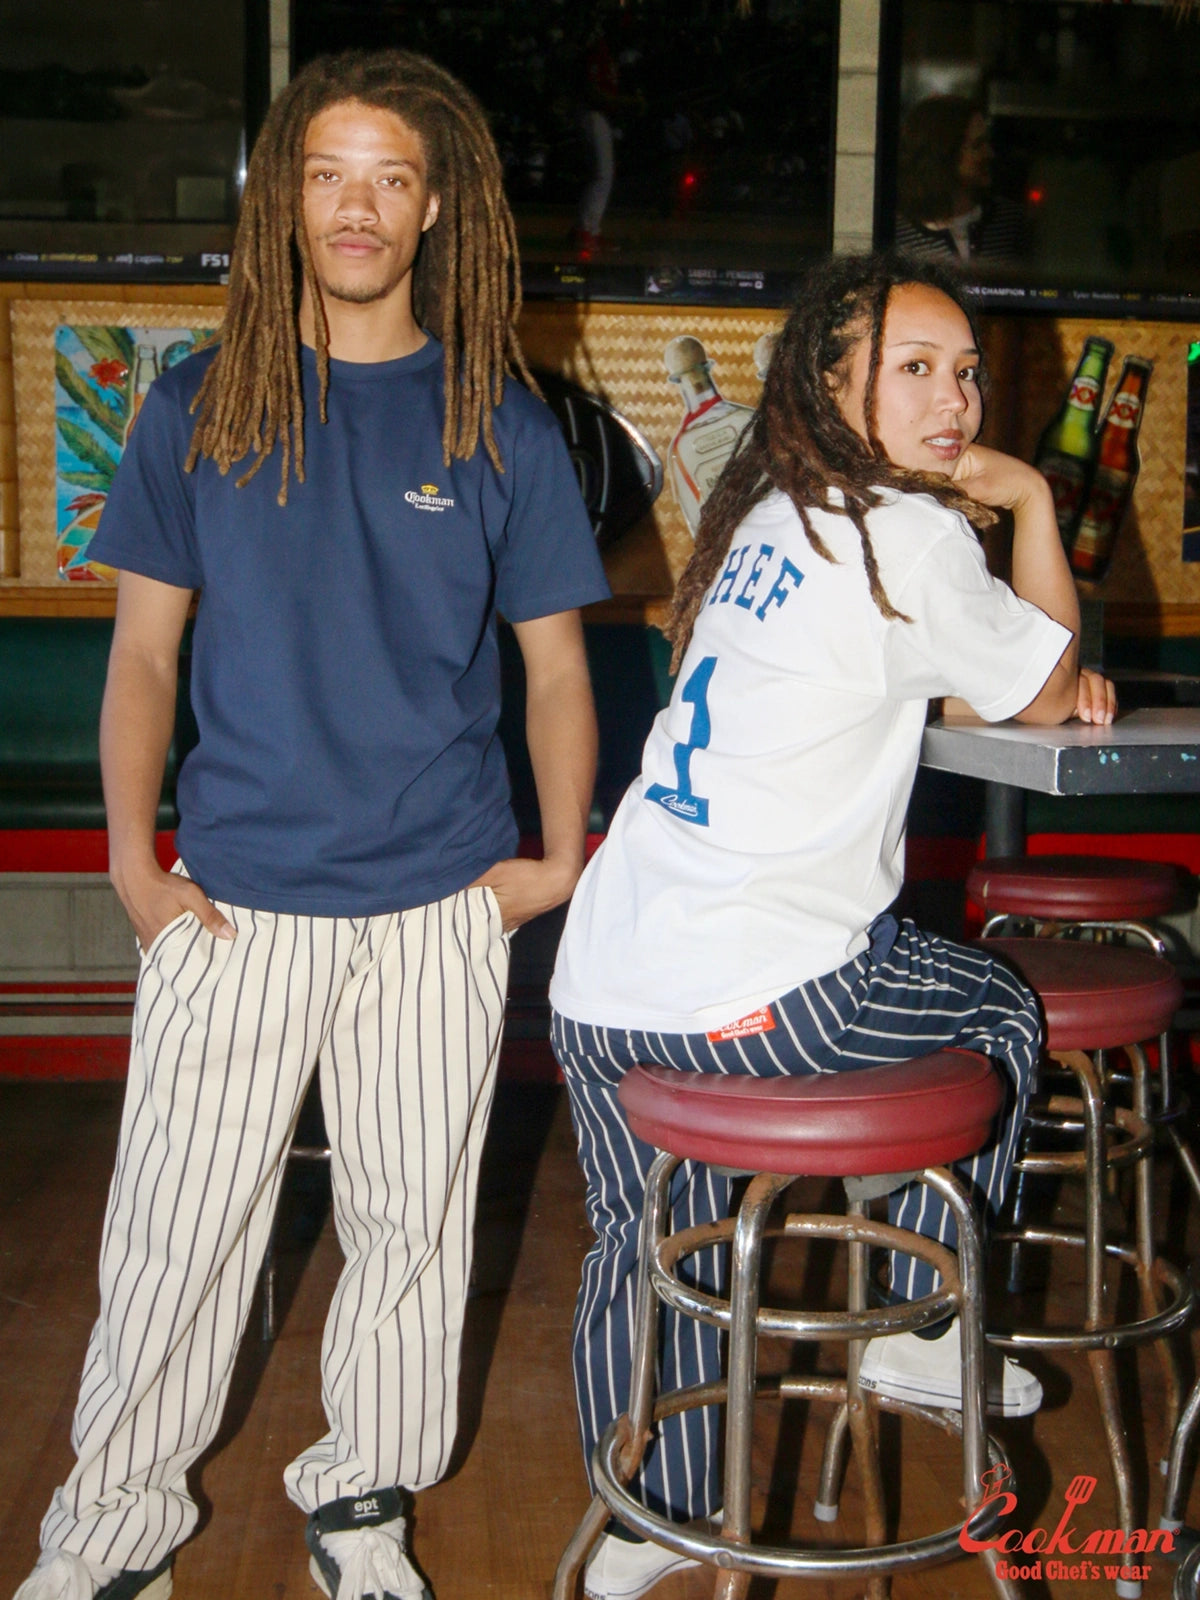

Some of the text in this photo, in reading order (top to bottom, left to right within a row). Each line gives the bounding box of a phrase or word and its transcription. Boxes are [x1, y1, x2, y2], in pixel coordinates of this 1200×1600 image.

[201, 253, 229, 267] FS1
[404, 491, 454, 507] Cookman
[700, 543, 805, 622] HEF
[643, 656, 718, 827] 1
[354, 1498, 379, 1513] ept
